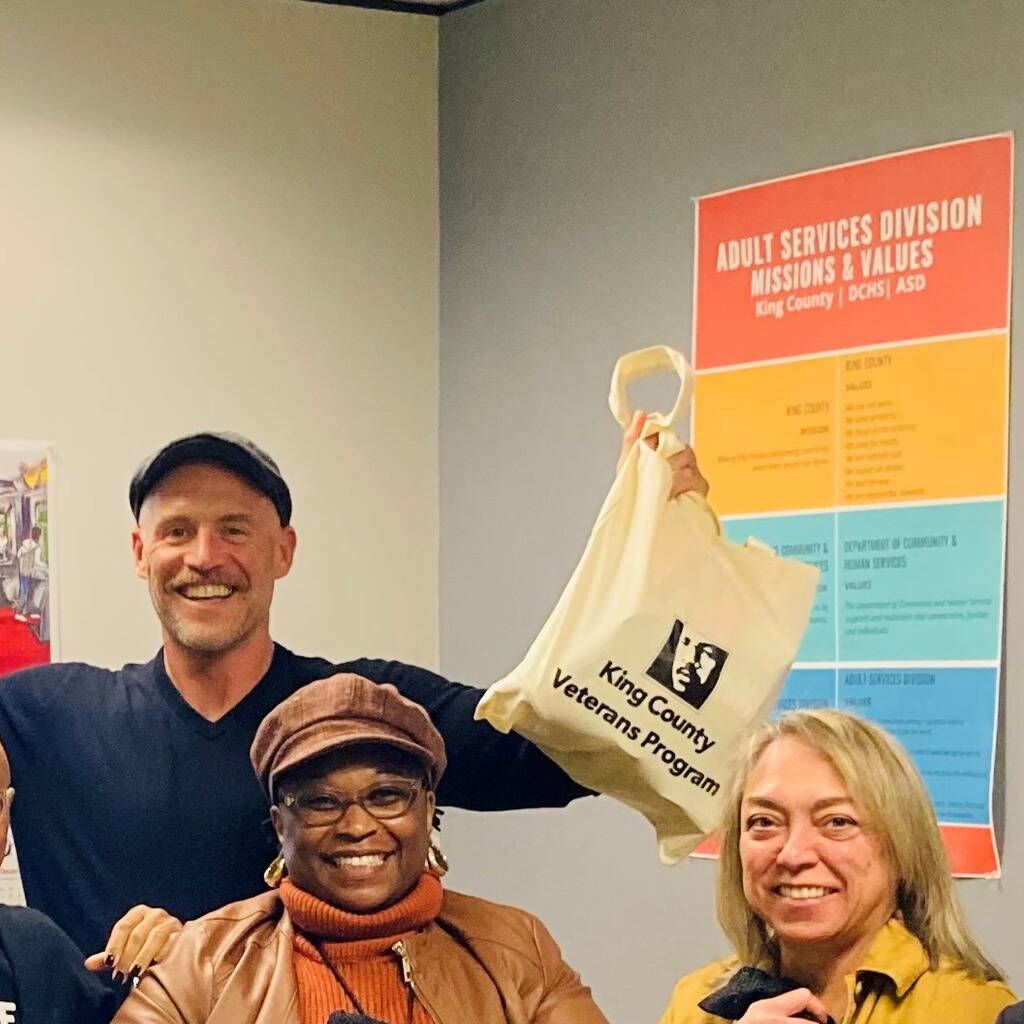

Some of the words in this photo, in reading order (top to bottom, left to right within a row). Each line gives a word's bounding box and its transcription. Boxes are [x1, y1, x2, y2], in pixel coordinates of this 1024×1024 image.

[716, 233, 774, 272] ADULT
[780, 214, 873, 261] SERVICES
[880, 194, 983, 243] DIVISION
[751, 252, 836, 298] MISSIONS
[842, 254, 854, 281] &
[861, 239, 934, 278] VALUES
[755, 296, 784, 319] King
[787, 290, 834, 313] County
[896, 275, 926, 294] ASD
[864, 354, 892, 370] COUNTY
[844, 538, 890, 553] DEPARTMENT
[903, 535, 949, 550] COMMUNITY
[844, 557, 870, 570] HUMAN
[872, 555, 907, 570] SERVICES
[552, 667, 641, 741] Veterans
[640, 731, 720, 797] Program
[599, 660, 648, 708] King
[648, 695, 716, 754] County
